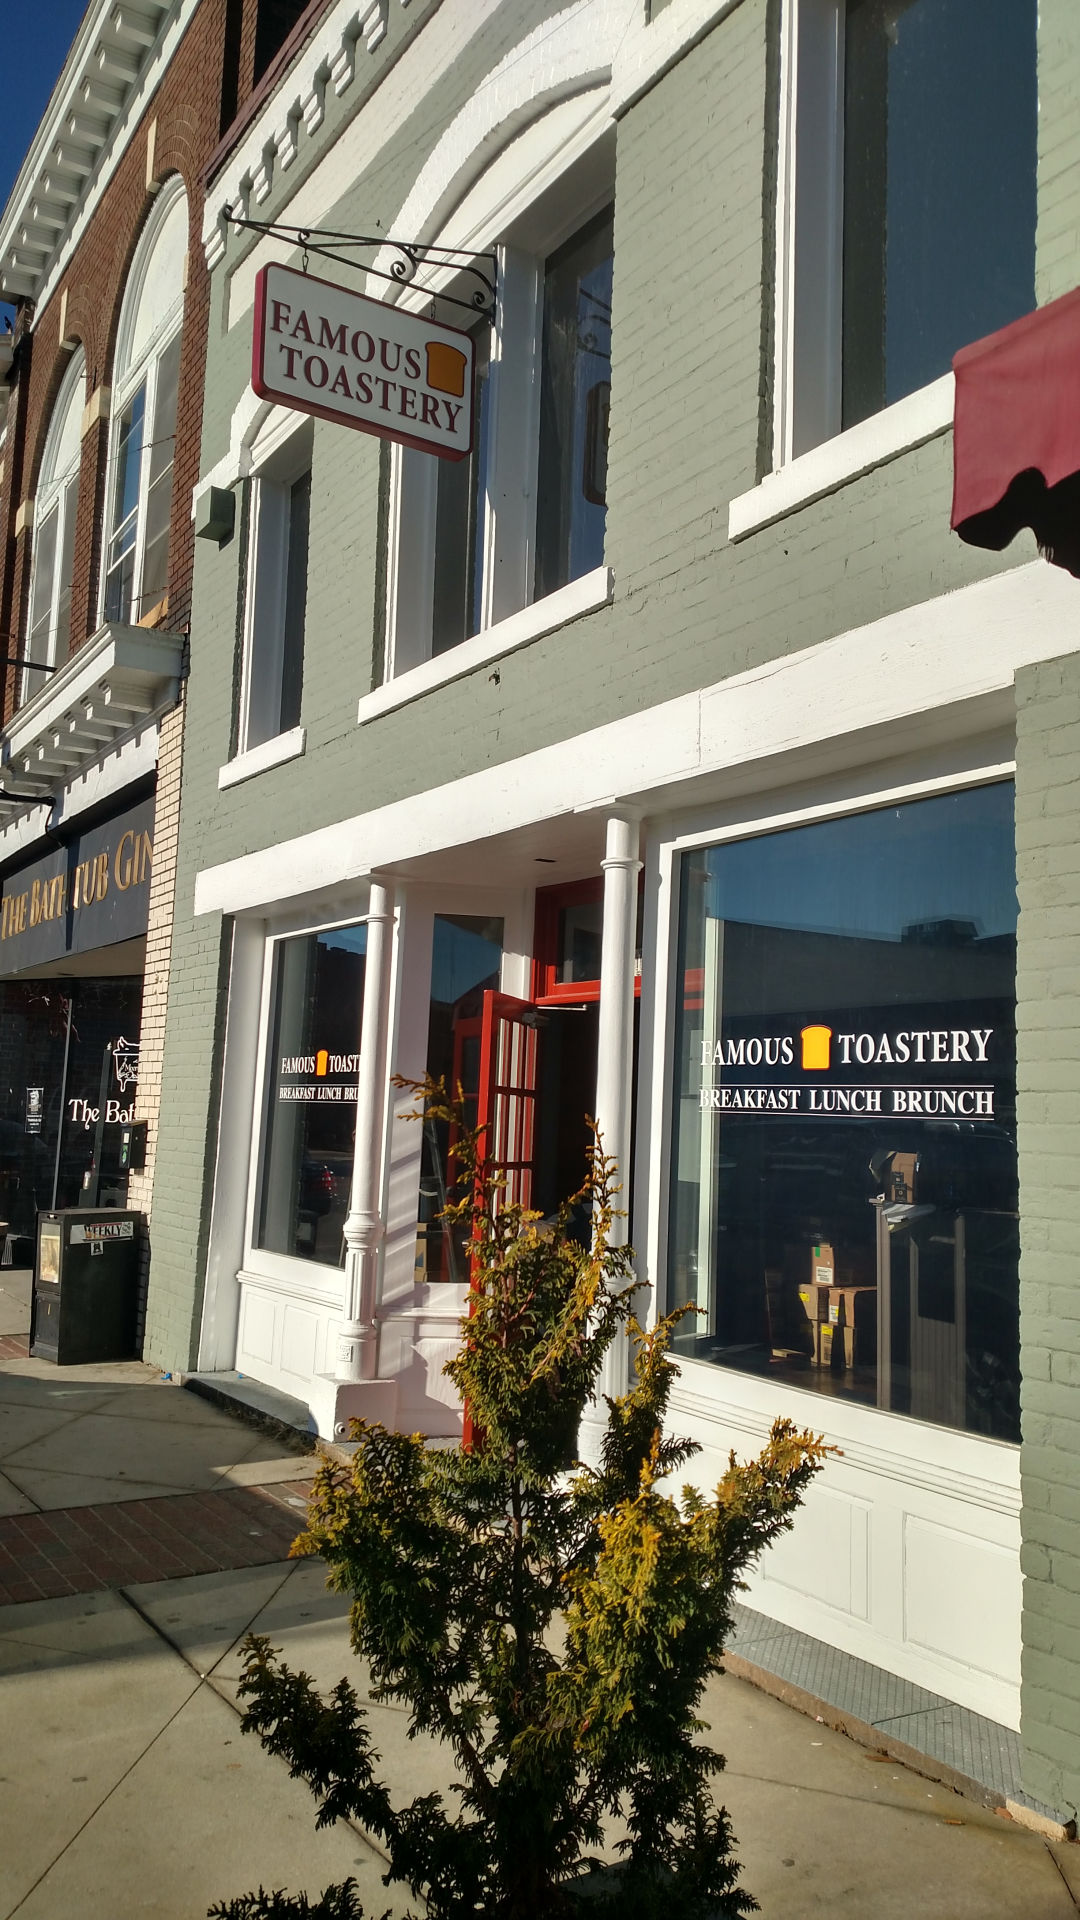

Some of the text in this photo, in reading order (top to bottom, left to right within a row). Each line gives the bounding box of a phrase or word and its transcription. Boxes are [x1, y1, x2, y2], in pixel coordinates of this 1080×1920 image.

[270, 300, 421, 379] FAMOUS
[279, 344, 463, 433] TOASTERY
[2, 892, 29, 940] THE
[73, 852, 110, 910] TUB
[281, 1056, 316, 1073] FAMOUS
[700, 1029, 993, 1066] FAMOUS TOASTERY
[279, 1087, 316, 1099] BREAKFAST
[317, 1087, 341, 1100] LUNCH
[699, 1088, 994, 1115] BREAKFAST LUNCH BRUNCH
[68, 1098, 100, 1130] The
